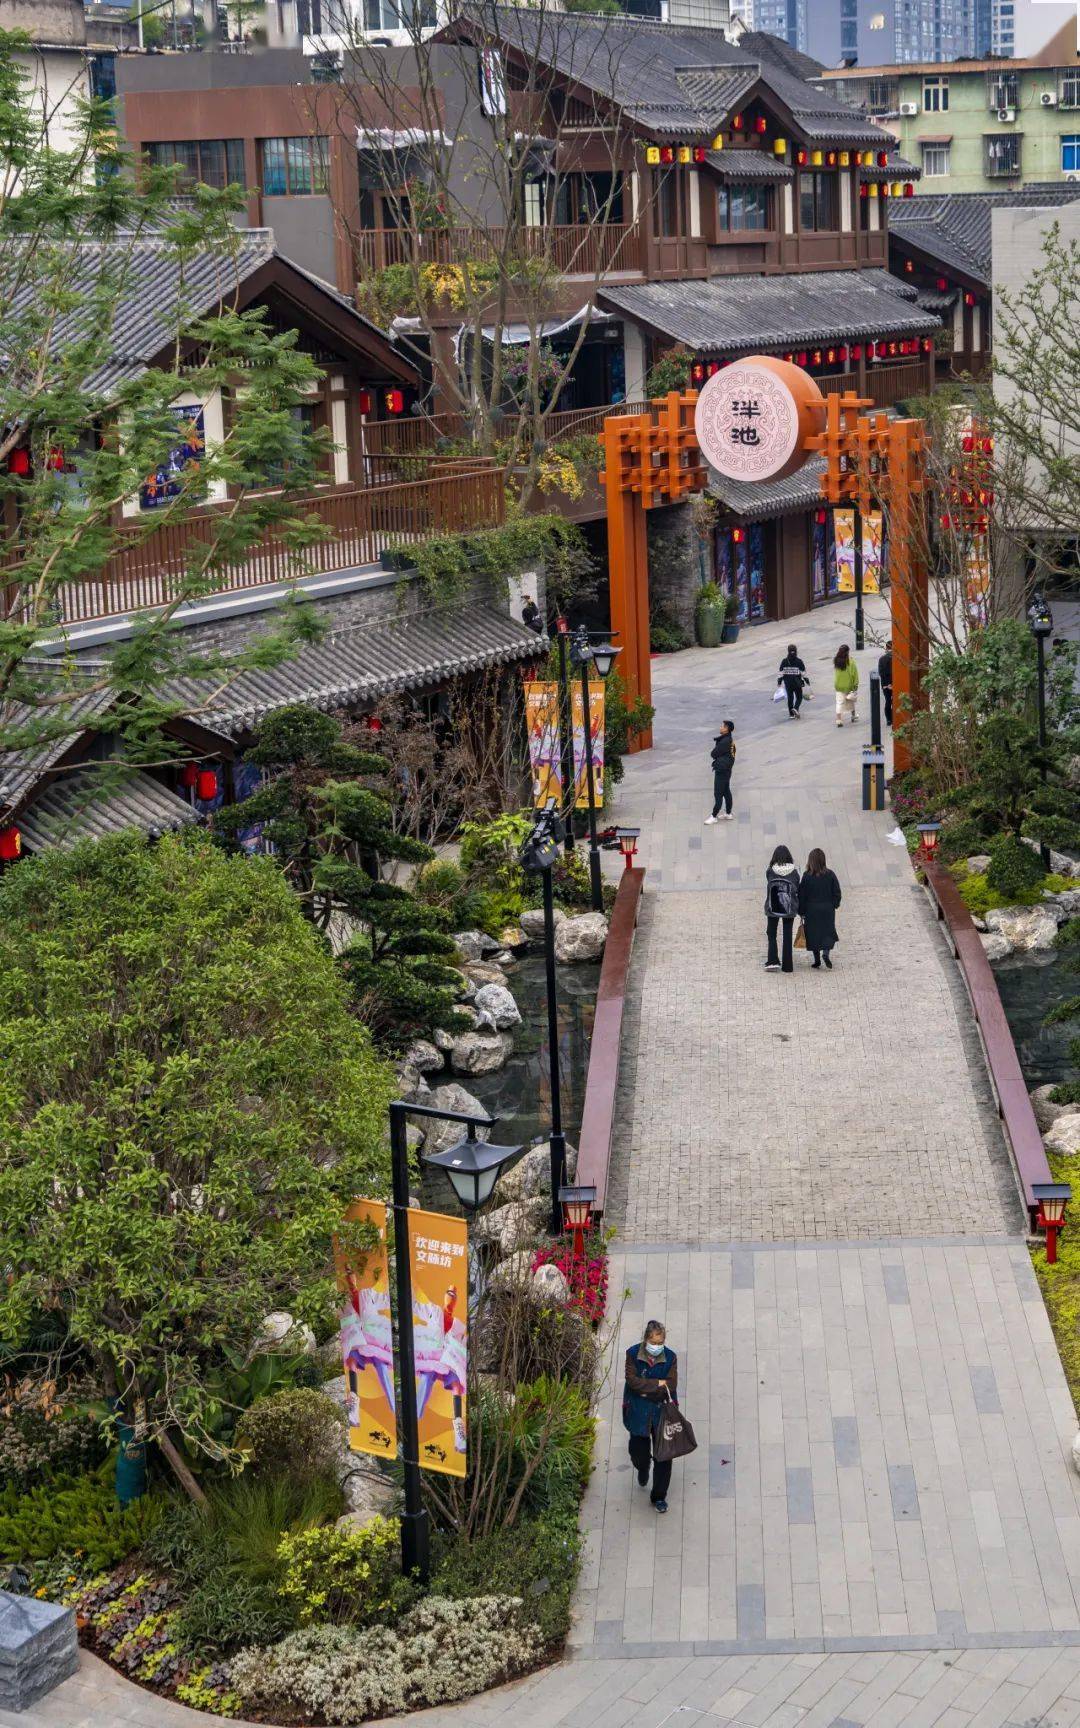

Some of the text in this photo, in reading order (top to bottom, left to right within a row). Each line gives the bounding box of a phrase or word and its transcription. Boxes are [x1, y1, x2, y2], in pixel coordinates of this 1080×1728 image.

[731, 399, 761, 446] 泮池
[416, 1237, 464, 1256] 欢迎来到
[416, 1250, 453, 1268] 文脉坊
